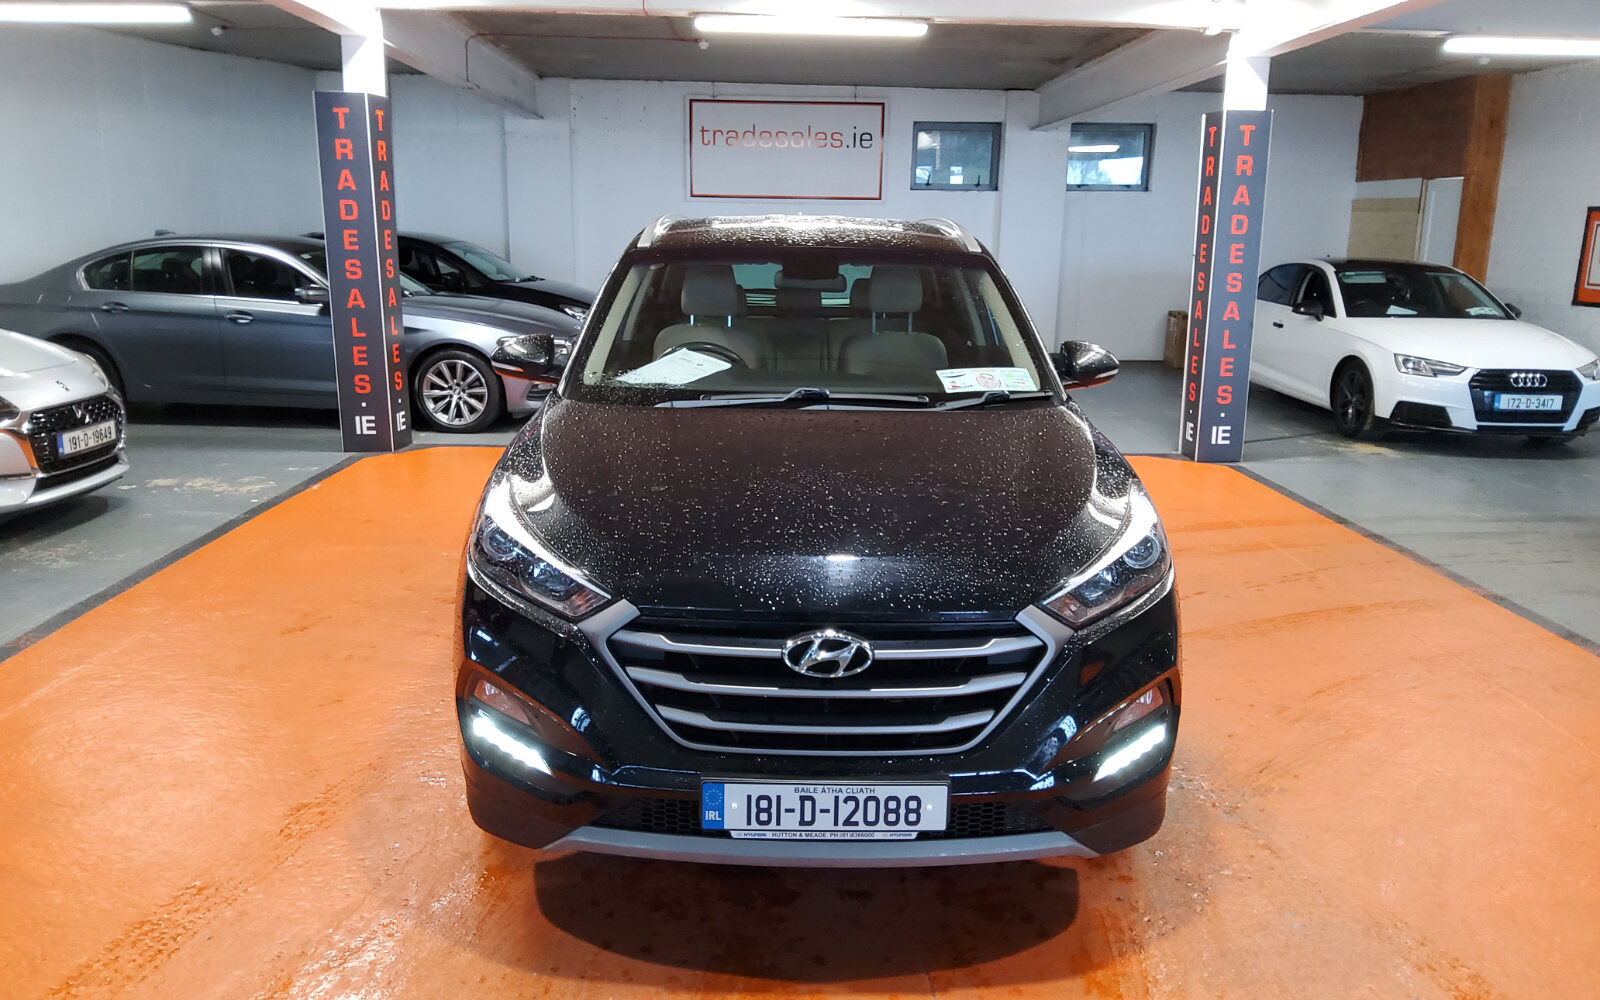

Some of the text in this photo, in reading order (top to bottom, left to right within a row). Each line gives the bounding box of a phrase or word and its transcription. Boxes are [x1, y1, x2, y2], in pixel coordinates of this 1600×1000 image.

[699, 123, 873, 149] tradesales.ie
[1507, 397, 1555, 409] 172-D-3417
[68, 425, 112, 451] 191-D-19649
[820, 785, 843, 794] ÁTHA
[845, 787, 876, 795] CLIATH
[705, 810, 722, 821] IRL
[746, 794, 922, 827] 181-D-12088
